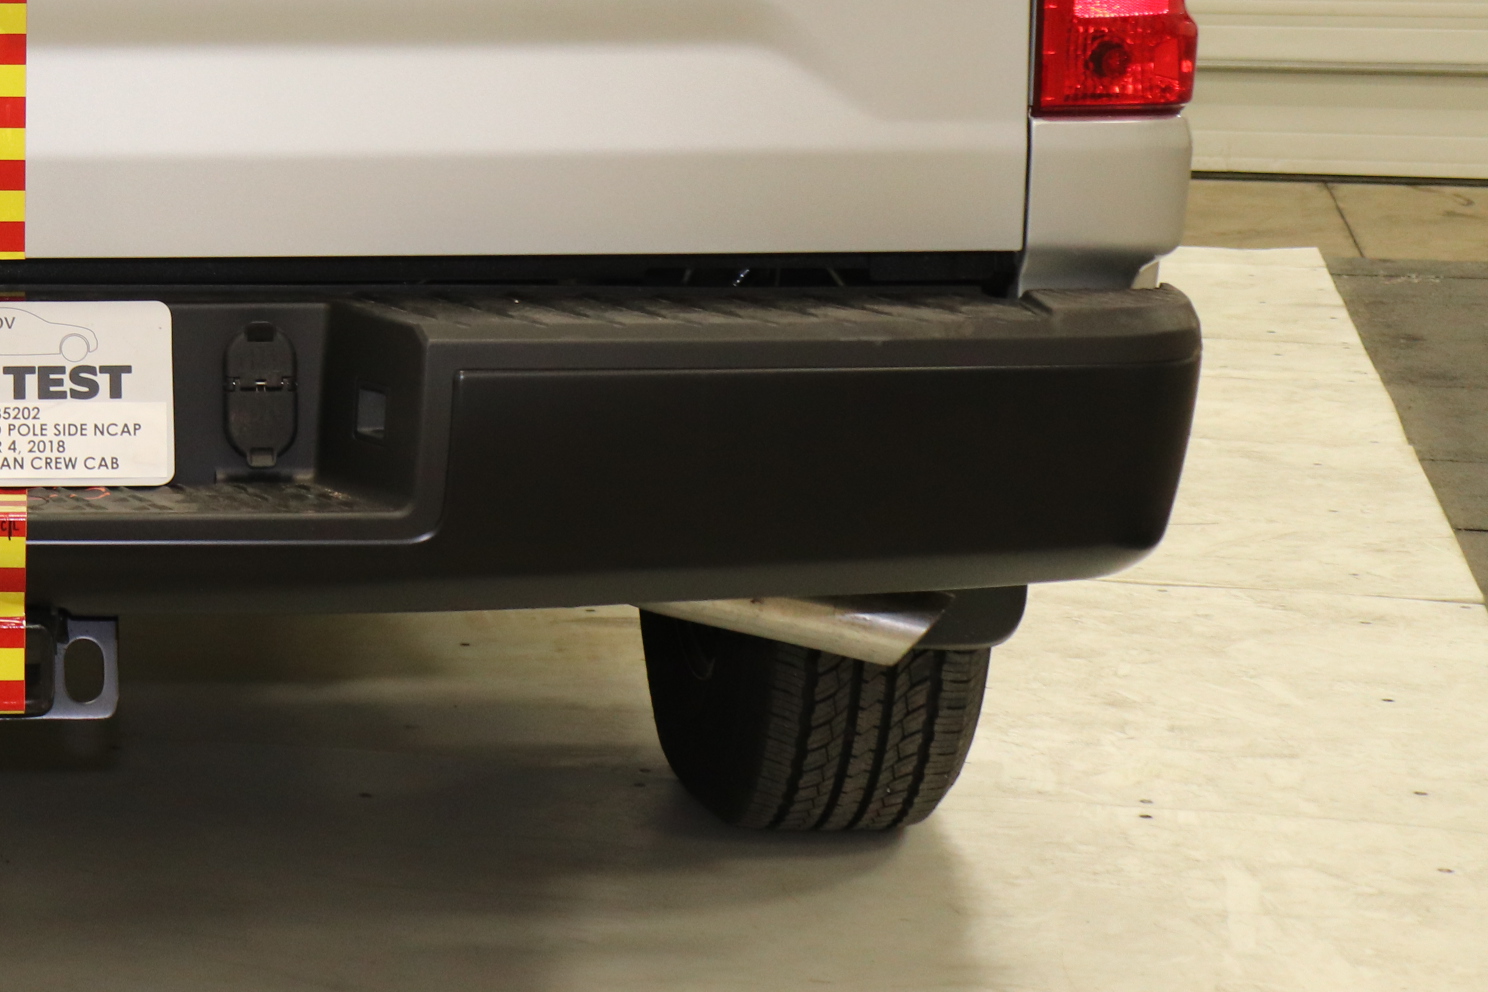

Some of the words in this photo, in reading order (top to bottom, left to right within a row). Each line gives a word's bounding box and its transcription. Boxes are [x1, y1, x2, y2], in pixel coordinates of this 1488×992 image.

[2, 364, 133, 401] TEST
[8, 423, 48, 437] POLE
[53, 423, 88, 437] SIDE
[93, 422, 142, 437] NCAP
[7, 439, 21, 457] 4,
[27, 439, 66, 454] 2018
[30, 456, 78, 471] CREW
[83, 456, 120, 470] CAB
